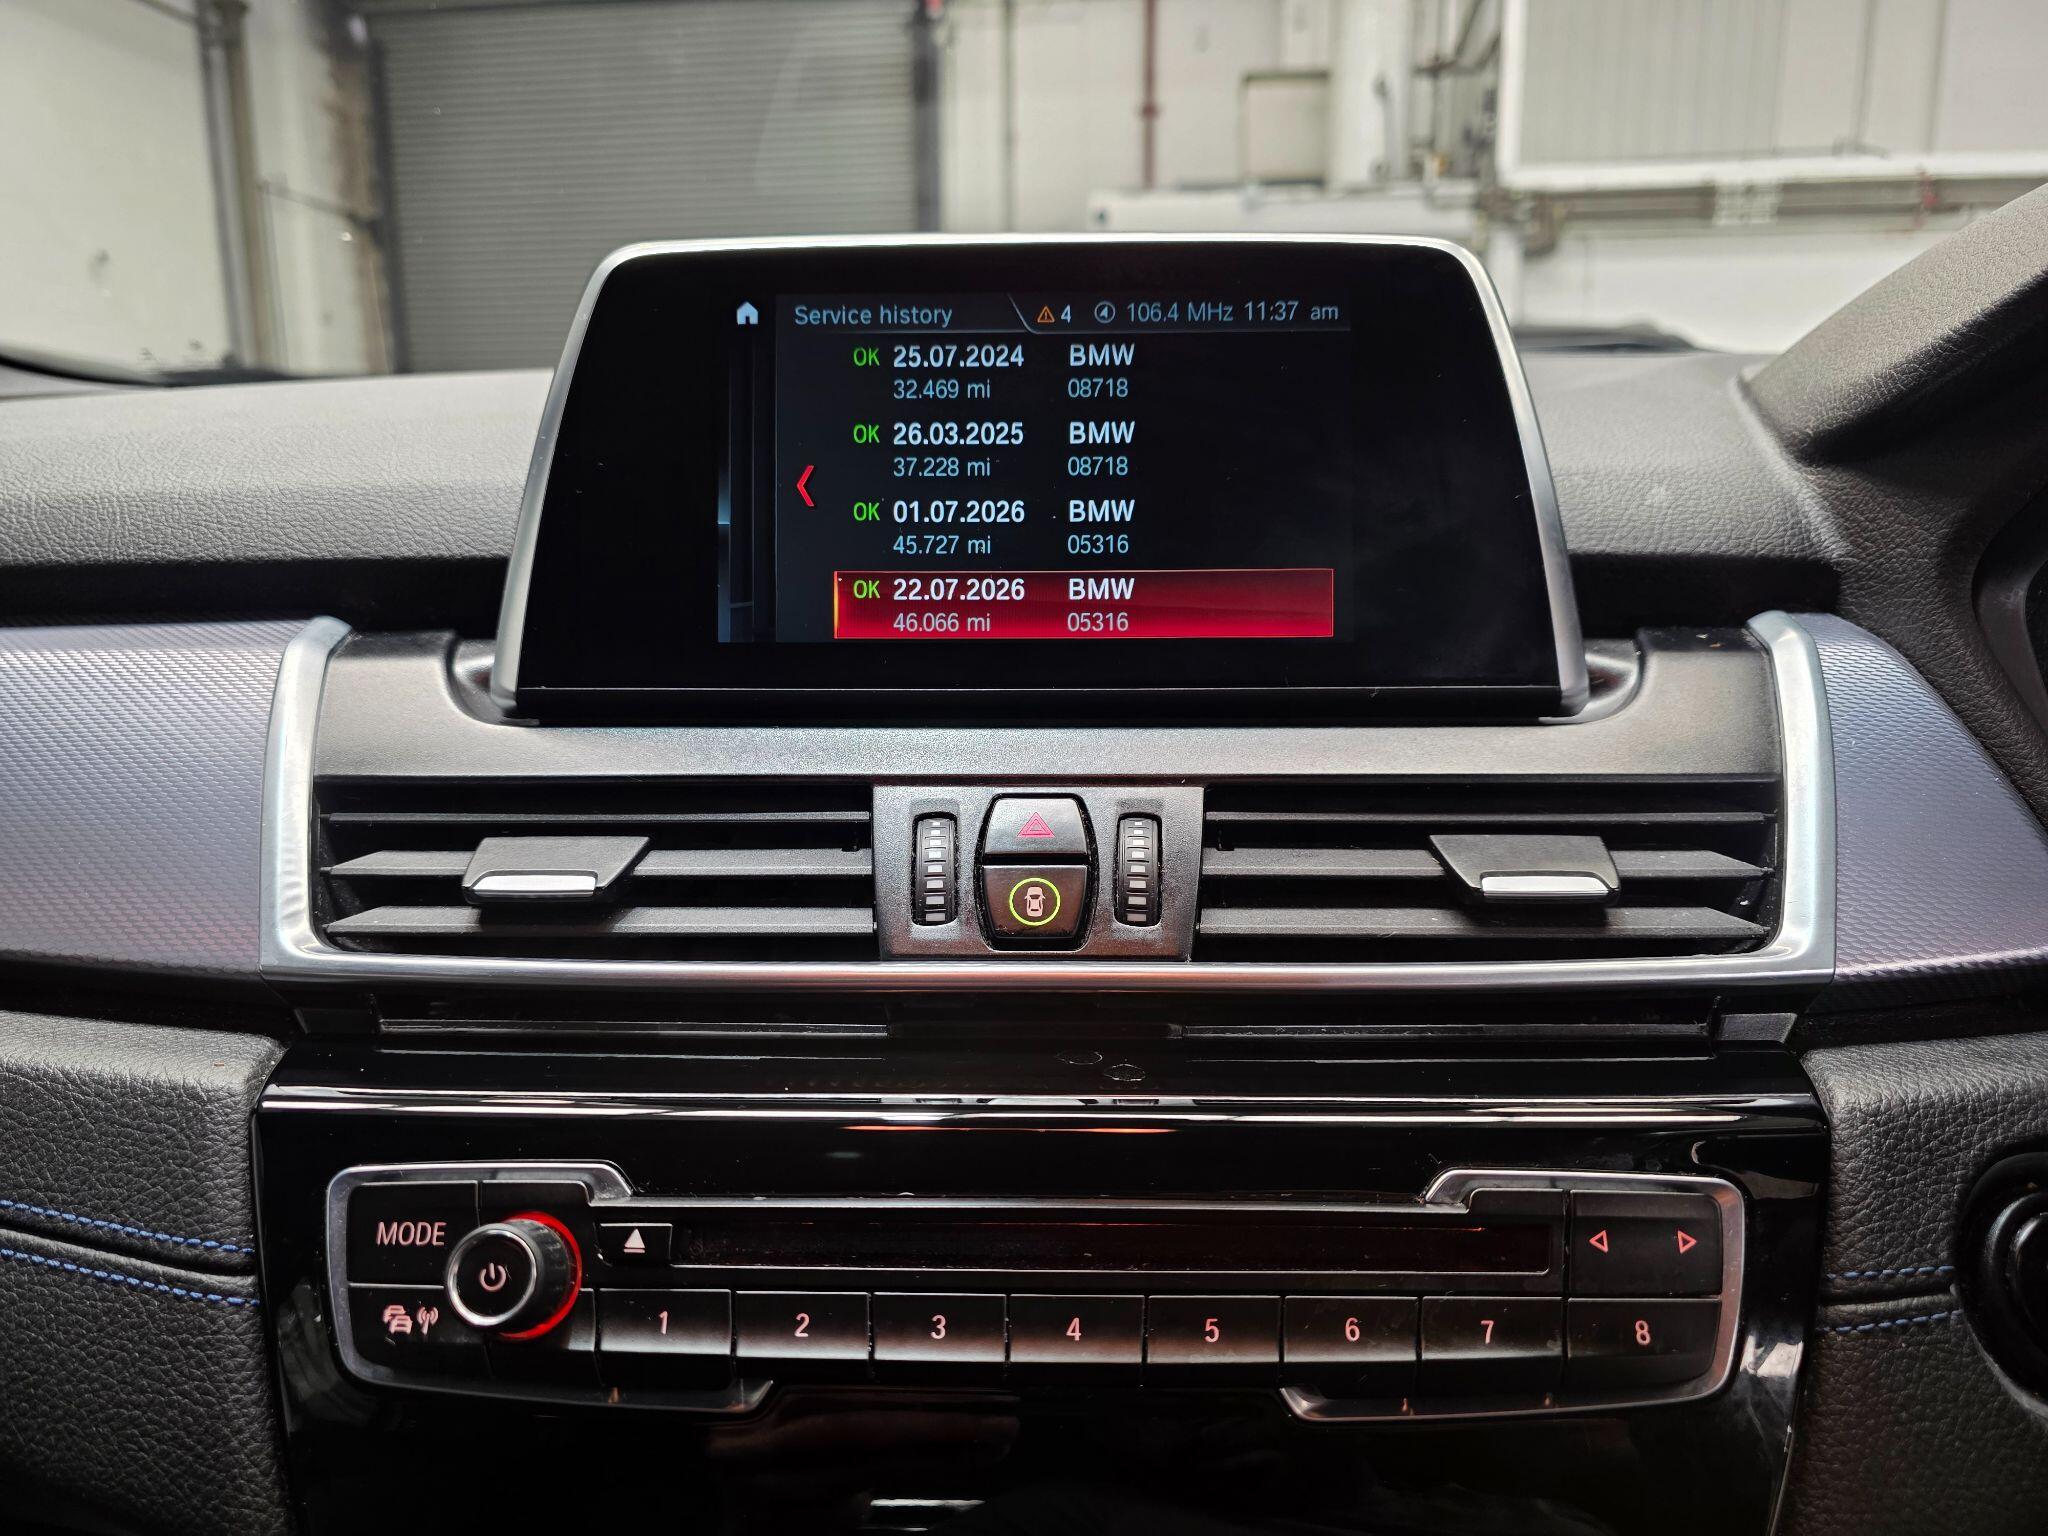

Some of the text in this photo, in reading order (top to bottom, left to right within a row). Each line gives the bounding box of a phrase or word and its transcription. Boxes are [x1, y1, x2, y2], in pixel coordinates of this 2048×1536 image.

[794, 305, 953, 328] Service history
[1060, 304, 1072, 324] 4
[1127, 300, 1339, 322] 106.4 MHz 11:37 am
[853, 343, 1135, 368] OK 25.07.2024 BMW
[893, 377, 1129, 400] 32.469 mi 08718
[853, 420, 1136, 446] OK 26.03.2025 BMW
[893, 455, 1129, 477] 37.228 mi 08718
[853, 499, 1136, 524] OK 01.07.2026 BMW
[892, 534, 1129, 555] 45.727 mi 05316
[853, 577, 1135, 601] OK 22.07.2026 BMW
[893, 611, 1129, 632] 46.066 mi 05316
[376, 1221, 447, 1246] MODE
[658, 1310, 669, 1335] 1
[794, 1312, 810, 1338] 2
[930, 1314, 947, 1340] 3
[1066, 1317, 1082, 1343] 4
[1203, 1318, 1221, 1344] 5
[1345, 1316, 1361, 1343] 6
[1480, 1319, 1495, 1345] 7
[1634, 1319, 1652, 1347] 8
